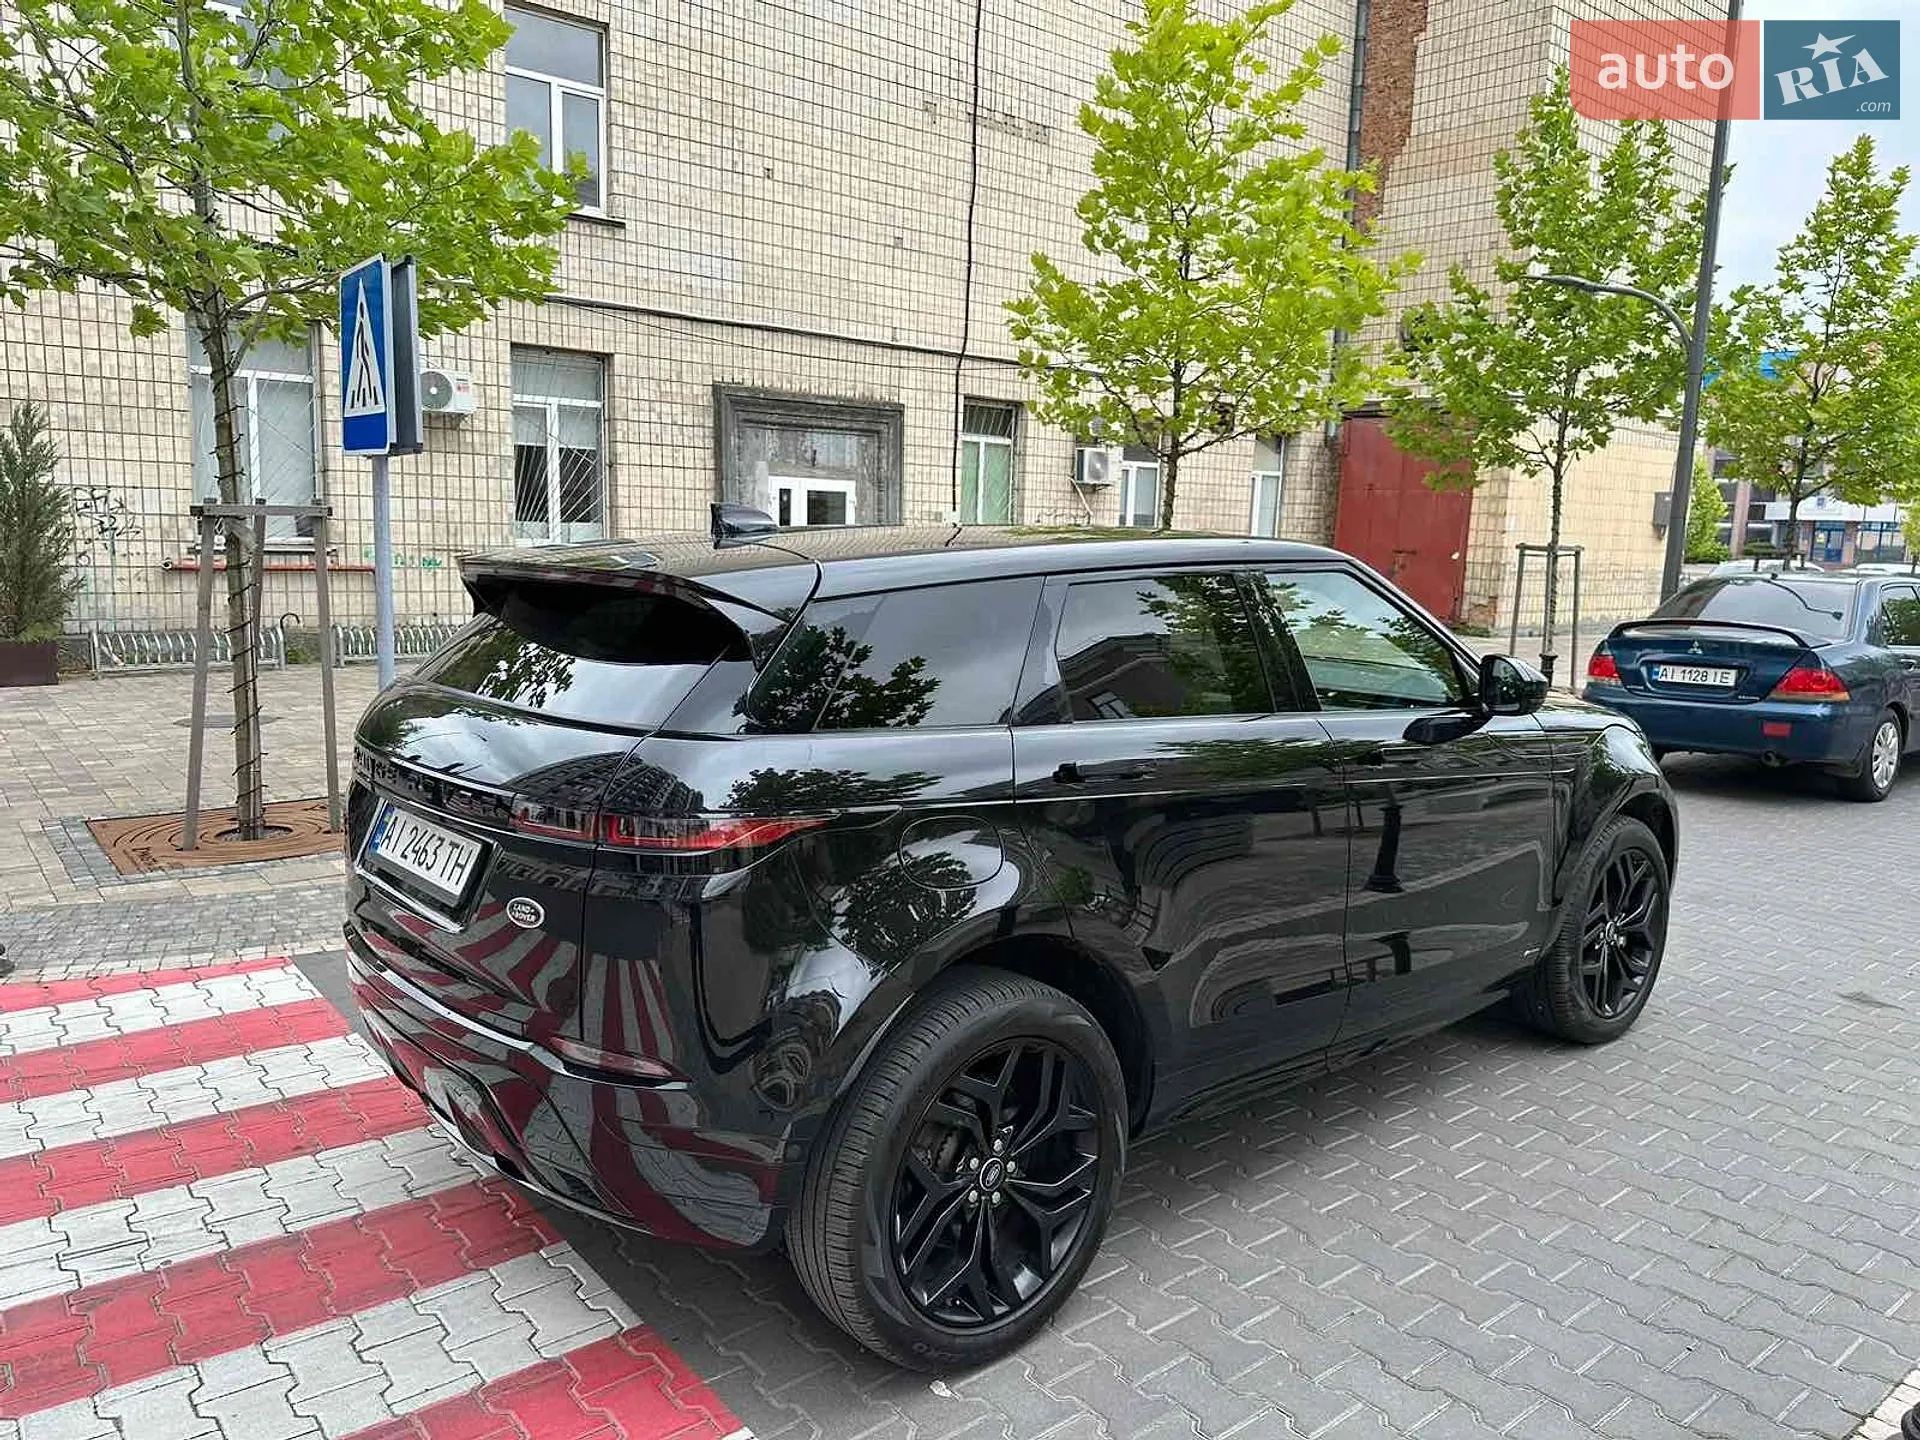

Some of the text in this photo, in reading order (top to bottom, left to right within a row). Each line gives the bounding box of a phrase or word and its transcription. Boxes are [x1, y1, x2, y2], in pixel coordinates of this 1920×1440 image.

[1659, 667, 1731, 684] AI 1128 IE
[380, 816, 473, 886] AI 2463 TH
